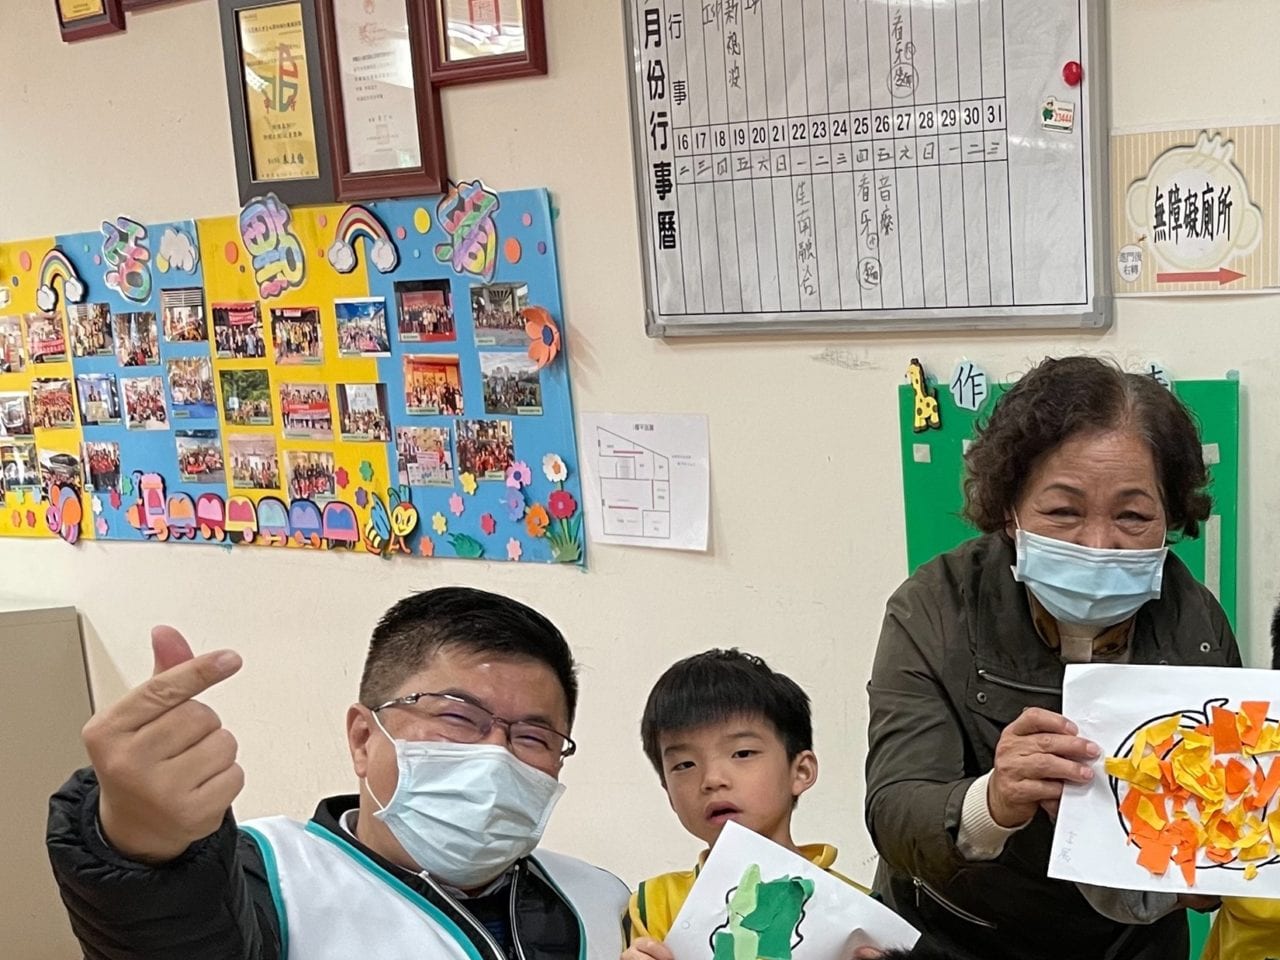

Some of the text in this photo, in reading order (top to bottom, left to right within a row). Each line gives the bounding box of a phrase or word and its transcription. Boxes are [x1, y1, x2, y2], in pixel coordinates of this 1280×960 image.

[678, 105, 1002, 150] 16 17 18 19 20 21 22 23 24 25 26 27 28 29 30 31
